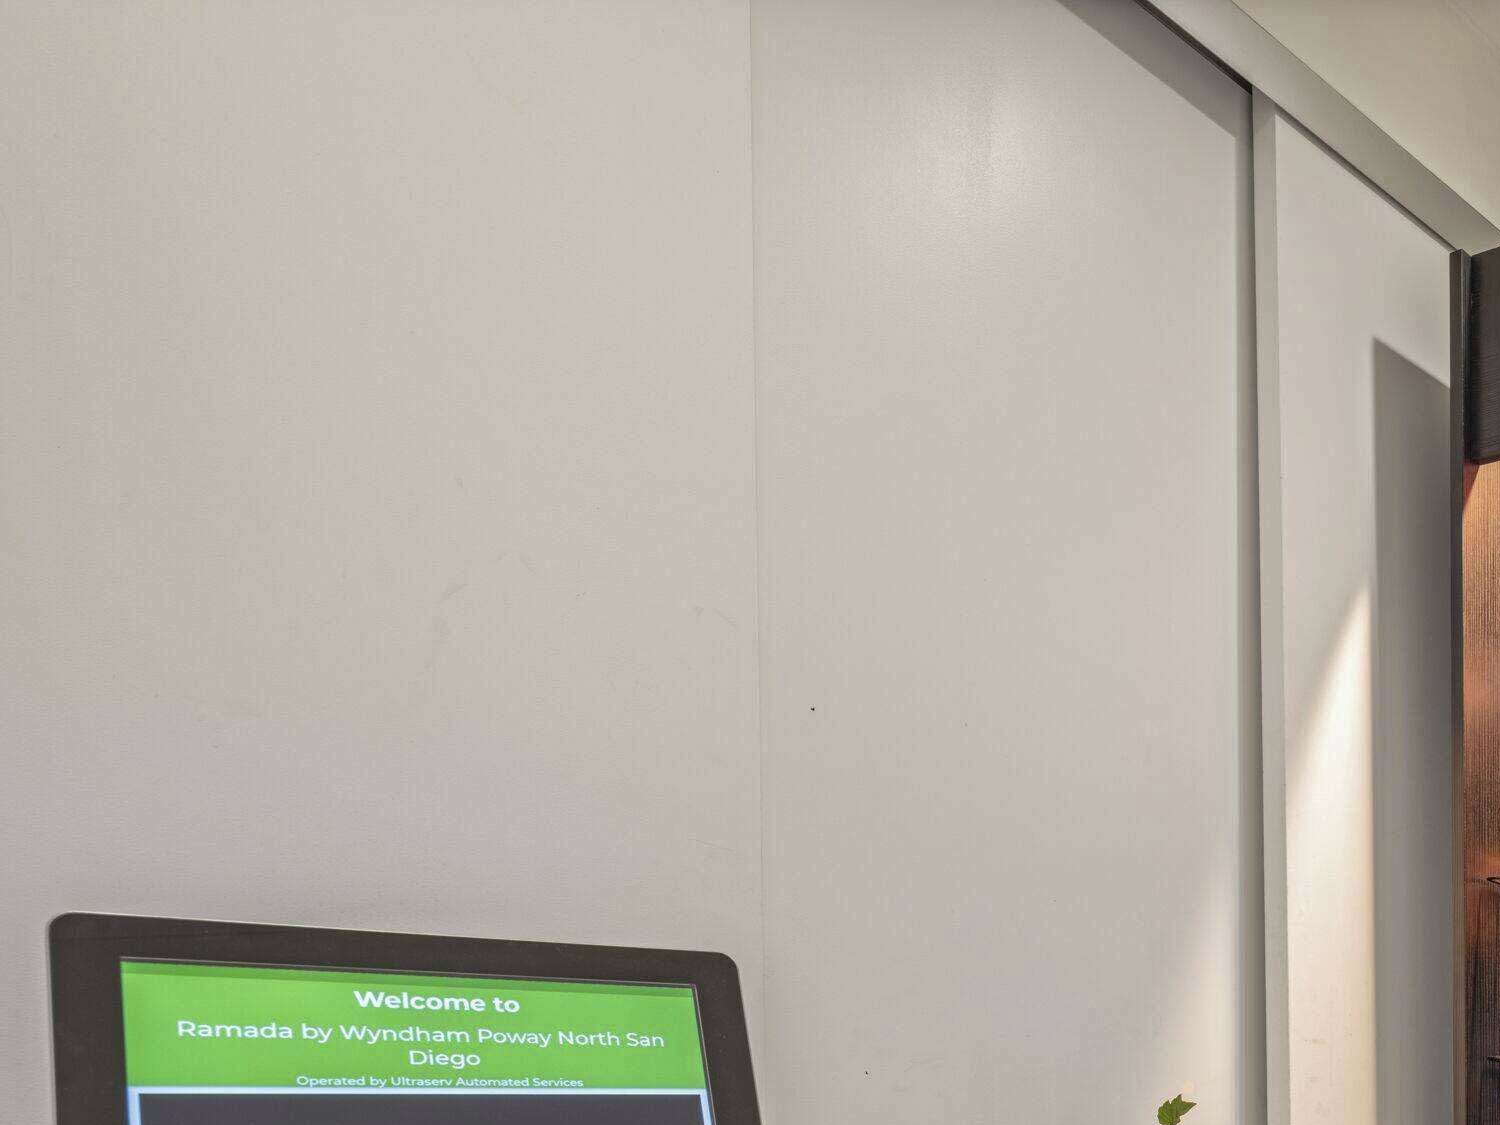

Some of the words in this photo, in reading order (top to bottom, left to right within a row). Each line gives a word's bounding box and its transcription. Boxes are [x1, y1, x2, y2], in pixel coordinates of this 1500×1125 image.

[353, 989, 486, 1013] Welcome
[492, 996, 521, 1014] to
[176, 1020, 294, 1039] Ramada
[302, 1022, 334, 1044] by
[339, 1023, 471, 1045] Wyndham
[477, 1028, 552, 1048] Poway
[558, 1030, 621, 1047] North
[626, 1031, 665, 1047] San
[408, 1049, 481, 1070] Diego
[296, 1075, 366, 1088] Operated
[369, 1076, 387, 1089] by
[390, 1076, 452, 1088] Ultraserv
[456, 1076, 530, 1088] Automated
[533, 1077, 584, 1089] Services
